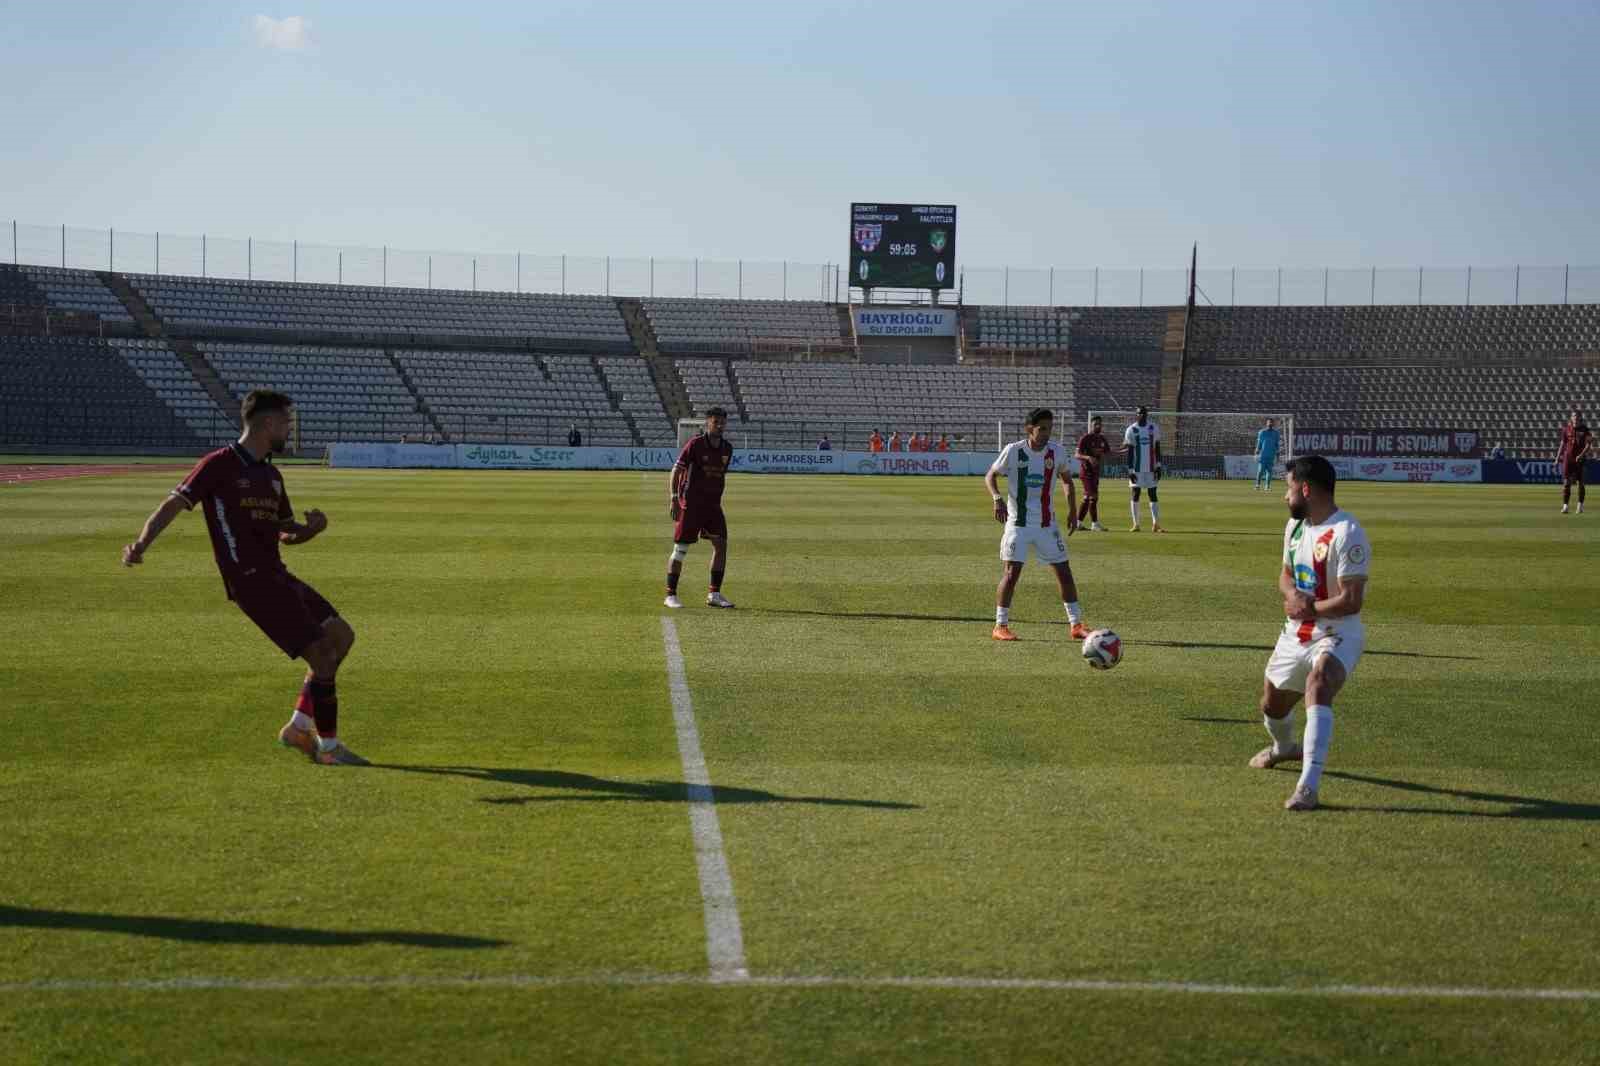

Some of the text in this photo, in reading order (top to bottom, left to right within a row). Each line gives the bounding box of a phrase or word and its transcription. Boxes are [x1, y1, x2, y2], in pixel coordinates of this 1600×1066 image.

[889, 243, 917, 256] 59:05
[861, 312, 942, 324] HAYRİOĞLU
[1342, 431, 1372, 451] BİTTİ
[1376, 435, 1393, 451] NE
[1397, 435, 1449, 452] SEVDAM
[748, 453, 833, 465] CAN KARDEŞLER
[880, 458, 950, 472] TURANLAR
[1392, 460, 1445, 471] ZENGİN
